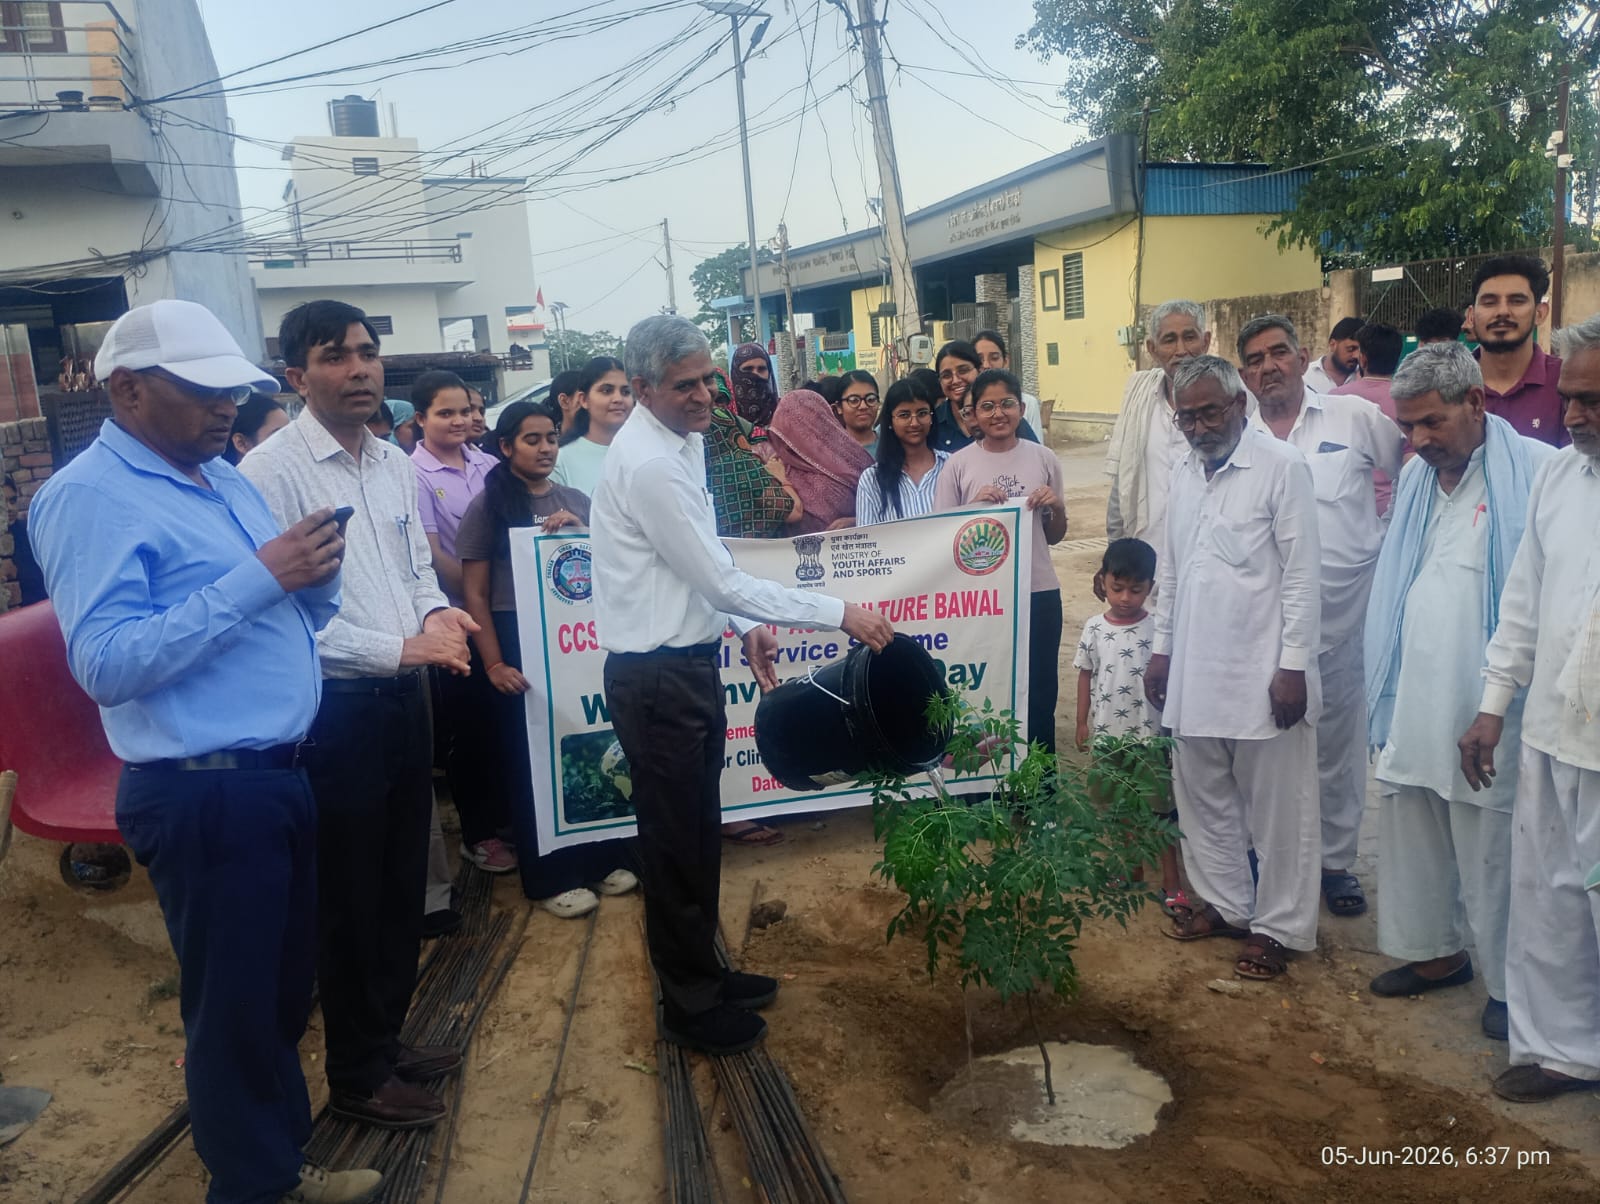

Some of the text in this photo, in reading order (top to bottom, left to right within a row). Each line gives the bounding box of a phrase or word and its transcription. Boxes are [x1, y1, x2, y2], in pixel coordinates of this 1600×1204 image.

[831, 550, 882, 560] MINISTRY OF
[832, 557, 905, 569] YOUTH AFFAIRS
[833, 567, 893, 578] AND SPORTS
[935, 589, 1004, 619] BAWAL
